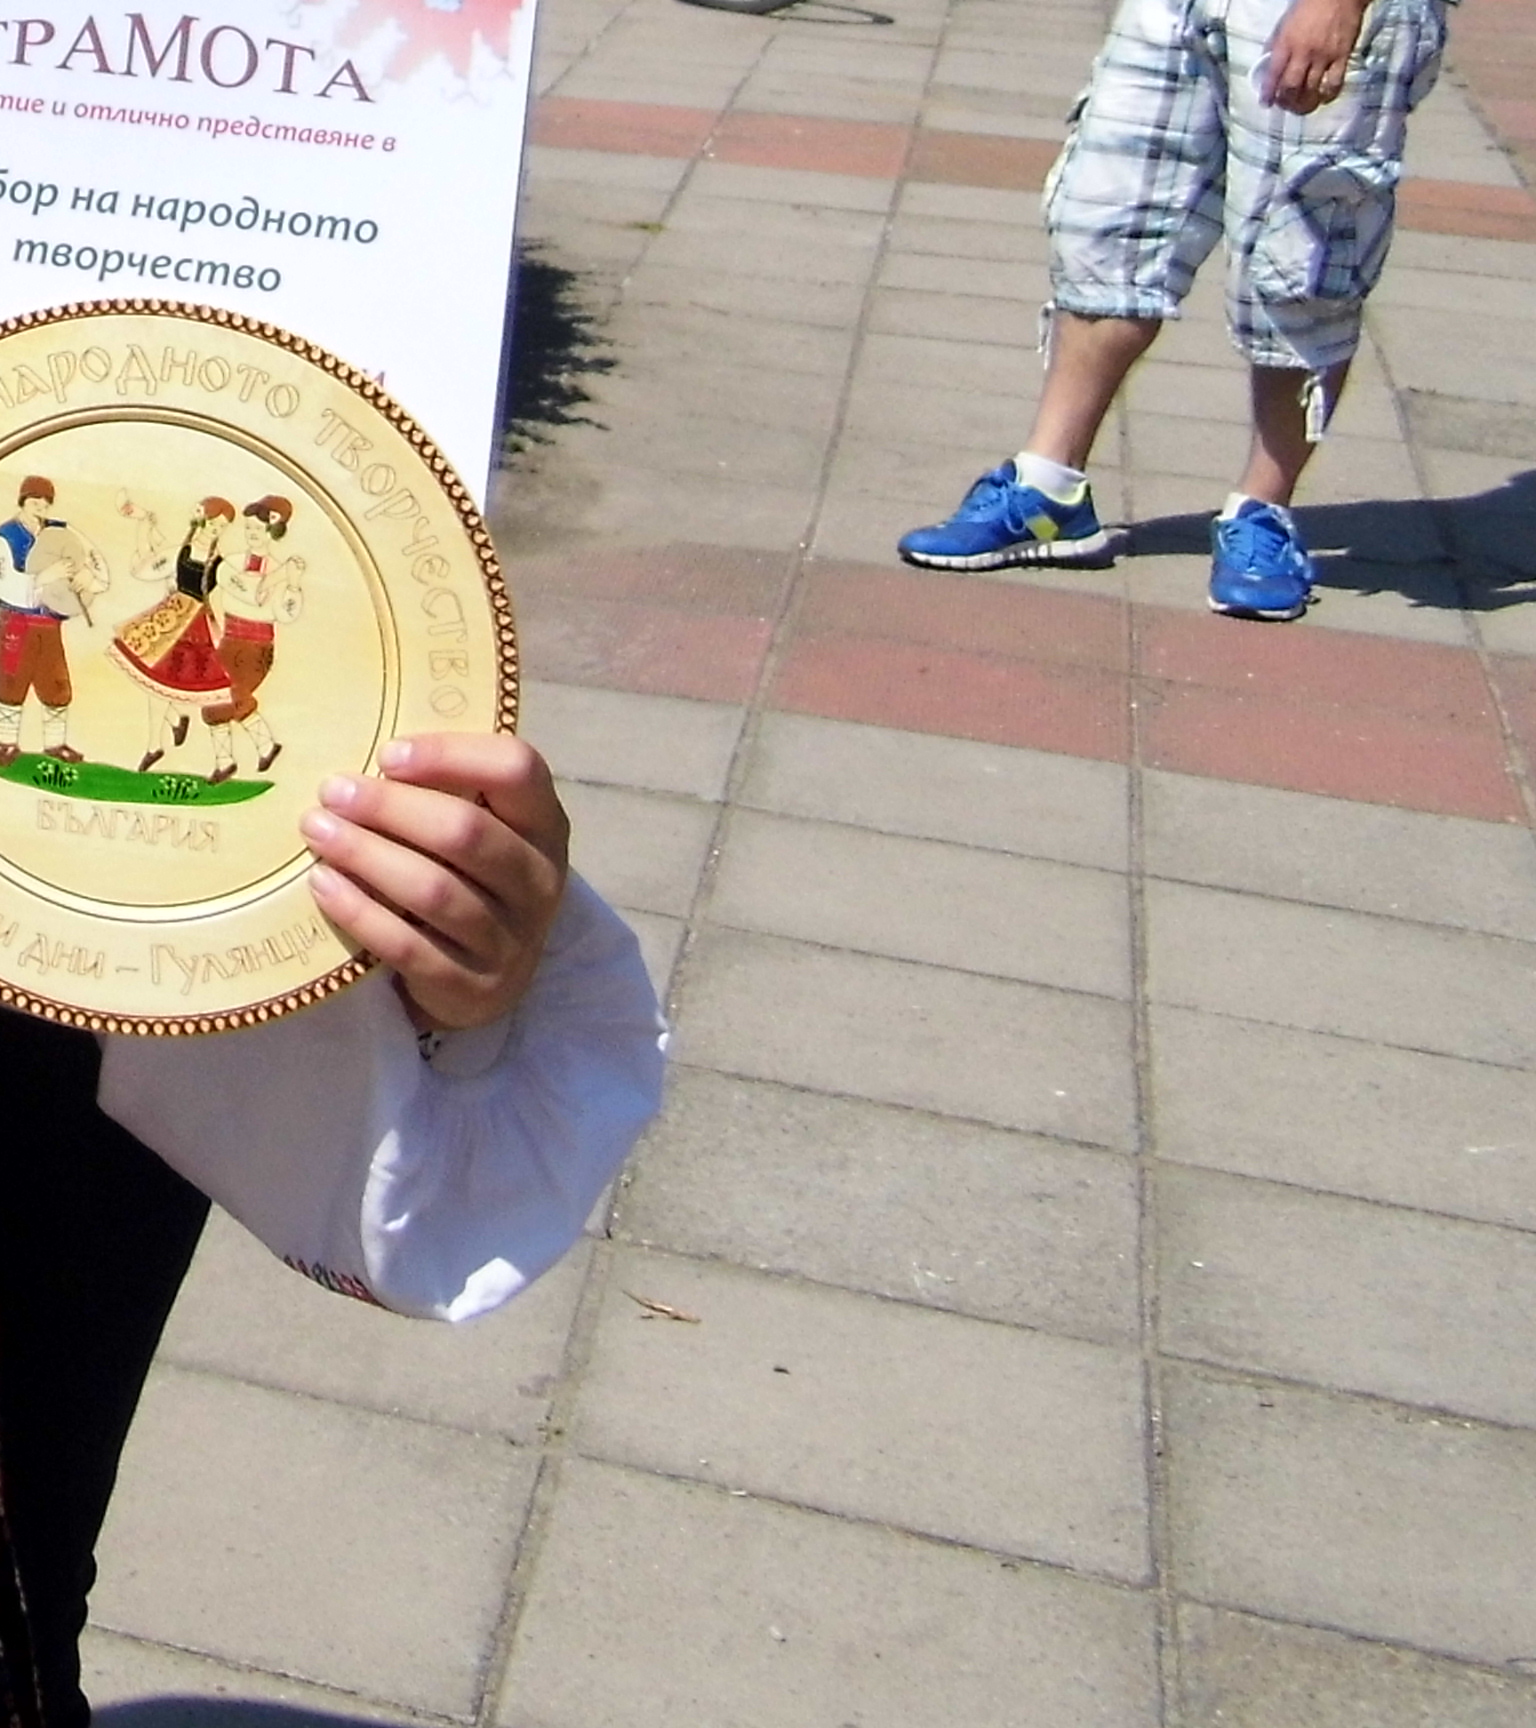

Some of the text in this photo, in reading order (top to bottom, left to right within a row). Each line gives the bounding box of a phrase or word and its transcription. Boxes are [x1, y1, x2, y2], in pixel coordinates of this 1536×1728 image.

[50, 99, 68, 118] и
[72, 101, 191, 131] отлично
[195, 114, 377, 152] представяне
[380, 135, 398, 154] в
[70, 187, 120, 215] на
[130, 193, 379, 244] народното
[13, 234, 282, 292] творчество
[36, 798, 221, 853] БЪЛГАРИЯ
